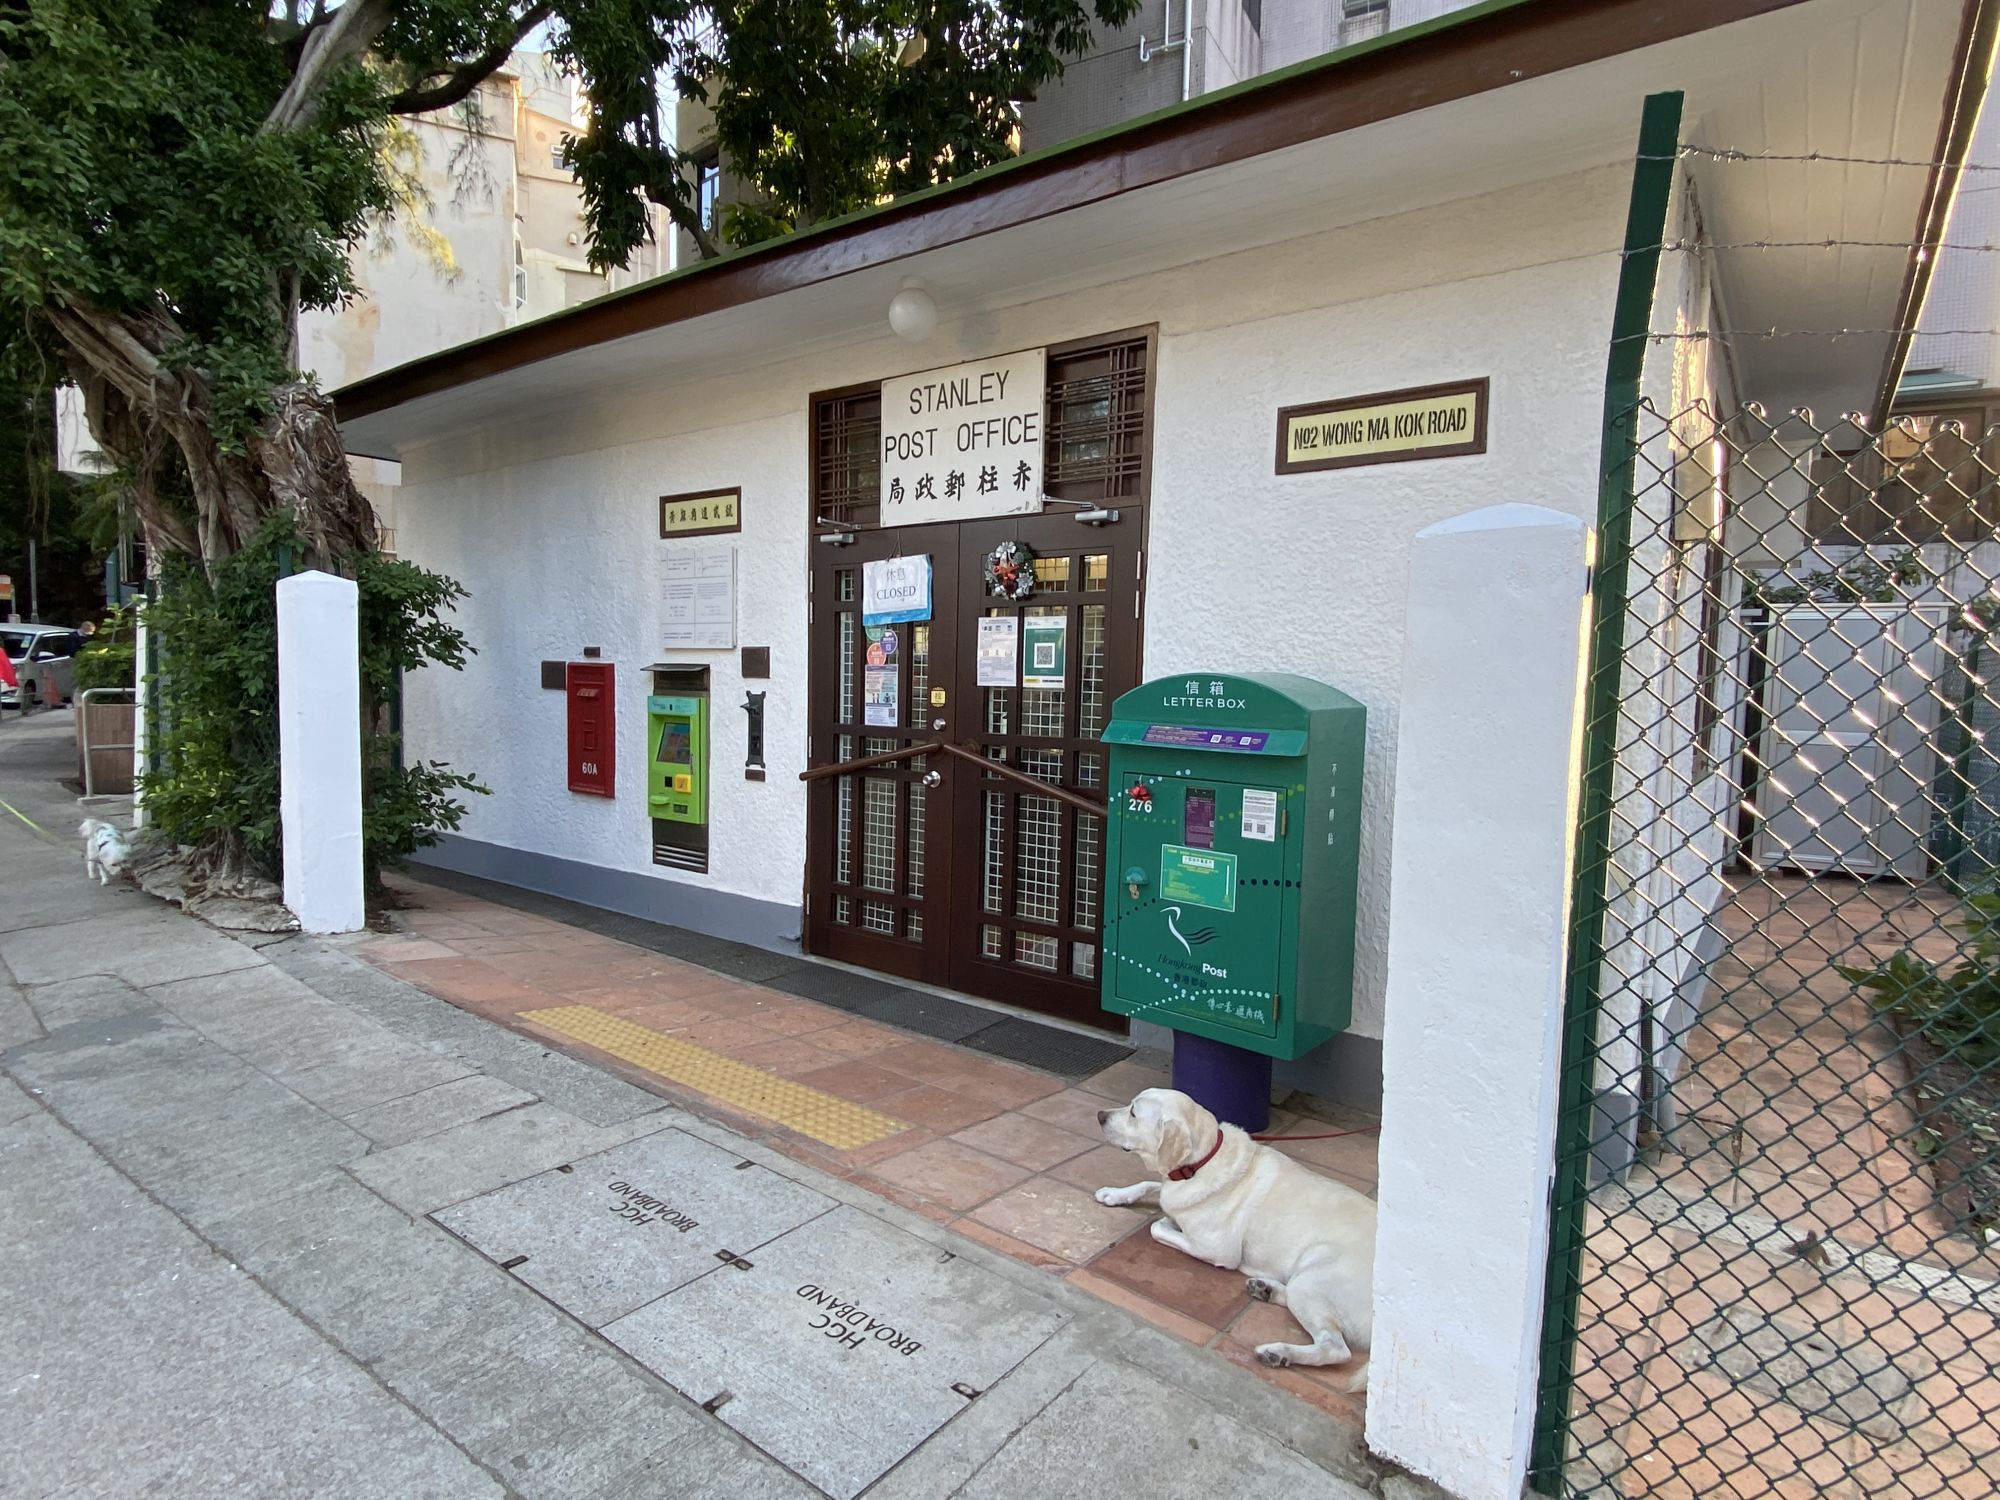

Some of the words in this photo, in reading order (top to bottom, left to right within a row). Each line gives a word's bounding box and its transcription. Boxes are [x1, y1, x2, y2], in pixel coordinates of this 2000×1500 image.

[909, 370, 1010, 415] STANLEY
[884, 428, 938, 463] POST
[956, 412, 1039, 452] OFFICE
[1322, 420, 1363, 447] WONG
[1367, 416, 1390, 442] MA
[1394, 411, 1424, 438] KOK
[1428, 407, 1467, 434] ROAD
[876, 585, 917, 600] CLOSED
[1185, 680, 1224, 696] 信箱
[1163, 696, 1214, 708] LETTER
[1217, 698, 1246, 709] BOX
[582, 762, 598, 775] 60A
[1128, 798, 1153, 813] 276
[1202, 962, 1228, 979] Post
[607, 1180, 700, 1233] BROADBAND
[609, 1200, 656, 1227] HGC
[796, 1283, 926, 1357] BROADBAND
[808, 1313, 867, 1351] HGC
